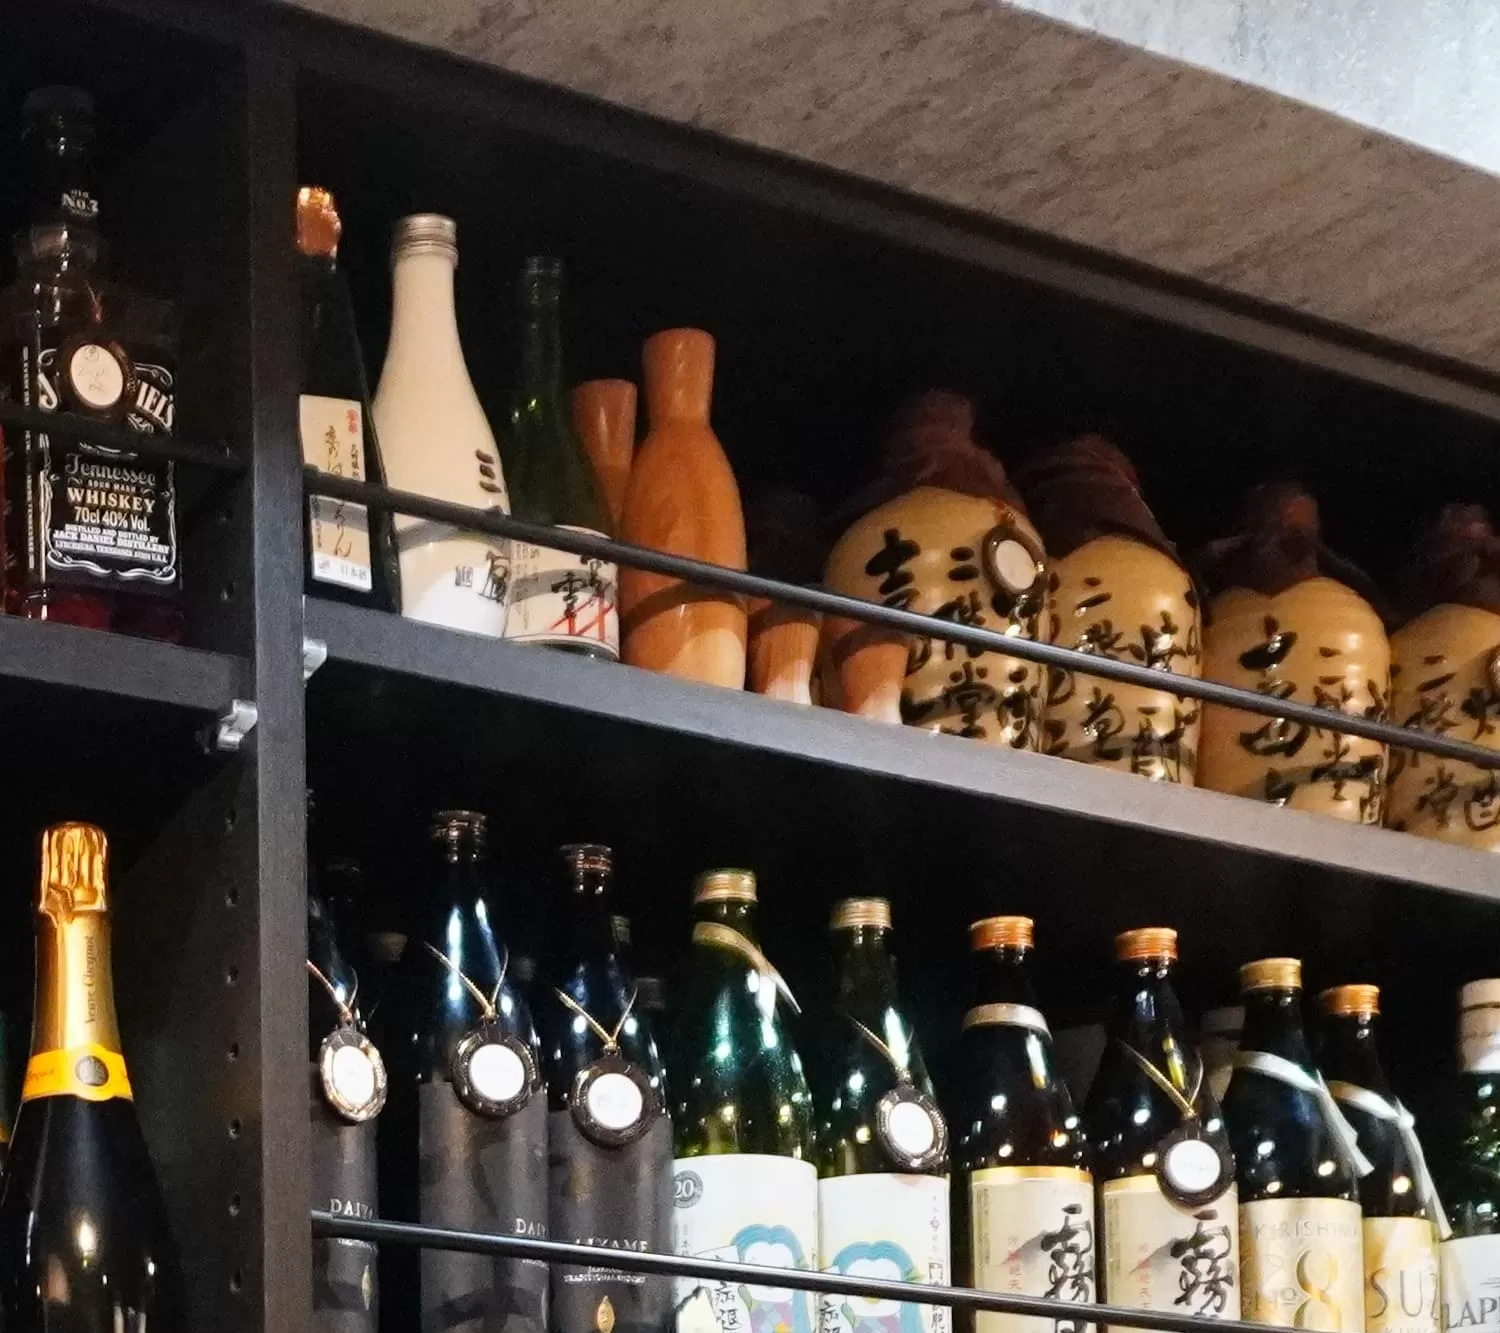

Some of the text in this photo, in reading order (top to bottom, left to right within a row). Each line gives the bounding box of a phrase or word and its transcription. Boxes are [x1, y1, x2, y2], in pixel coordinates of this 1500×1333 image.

[65, 452, 157, 486] Tennessee
[66, 486, 156, 514] WHISKEY
[73, 505, 151, 532] 70cl 40% Vol.
[52, 529, 170, 555] JACK DANIEL DISTILLERY
